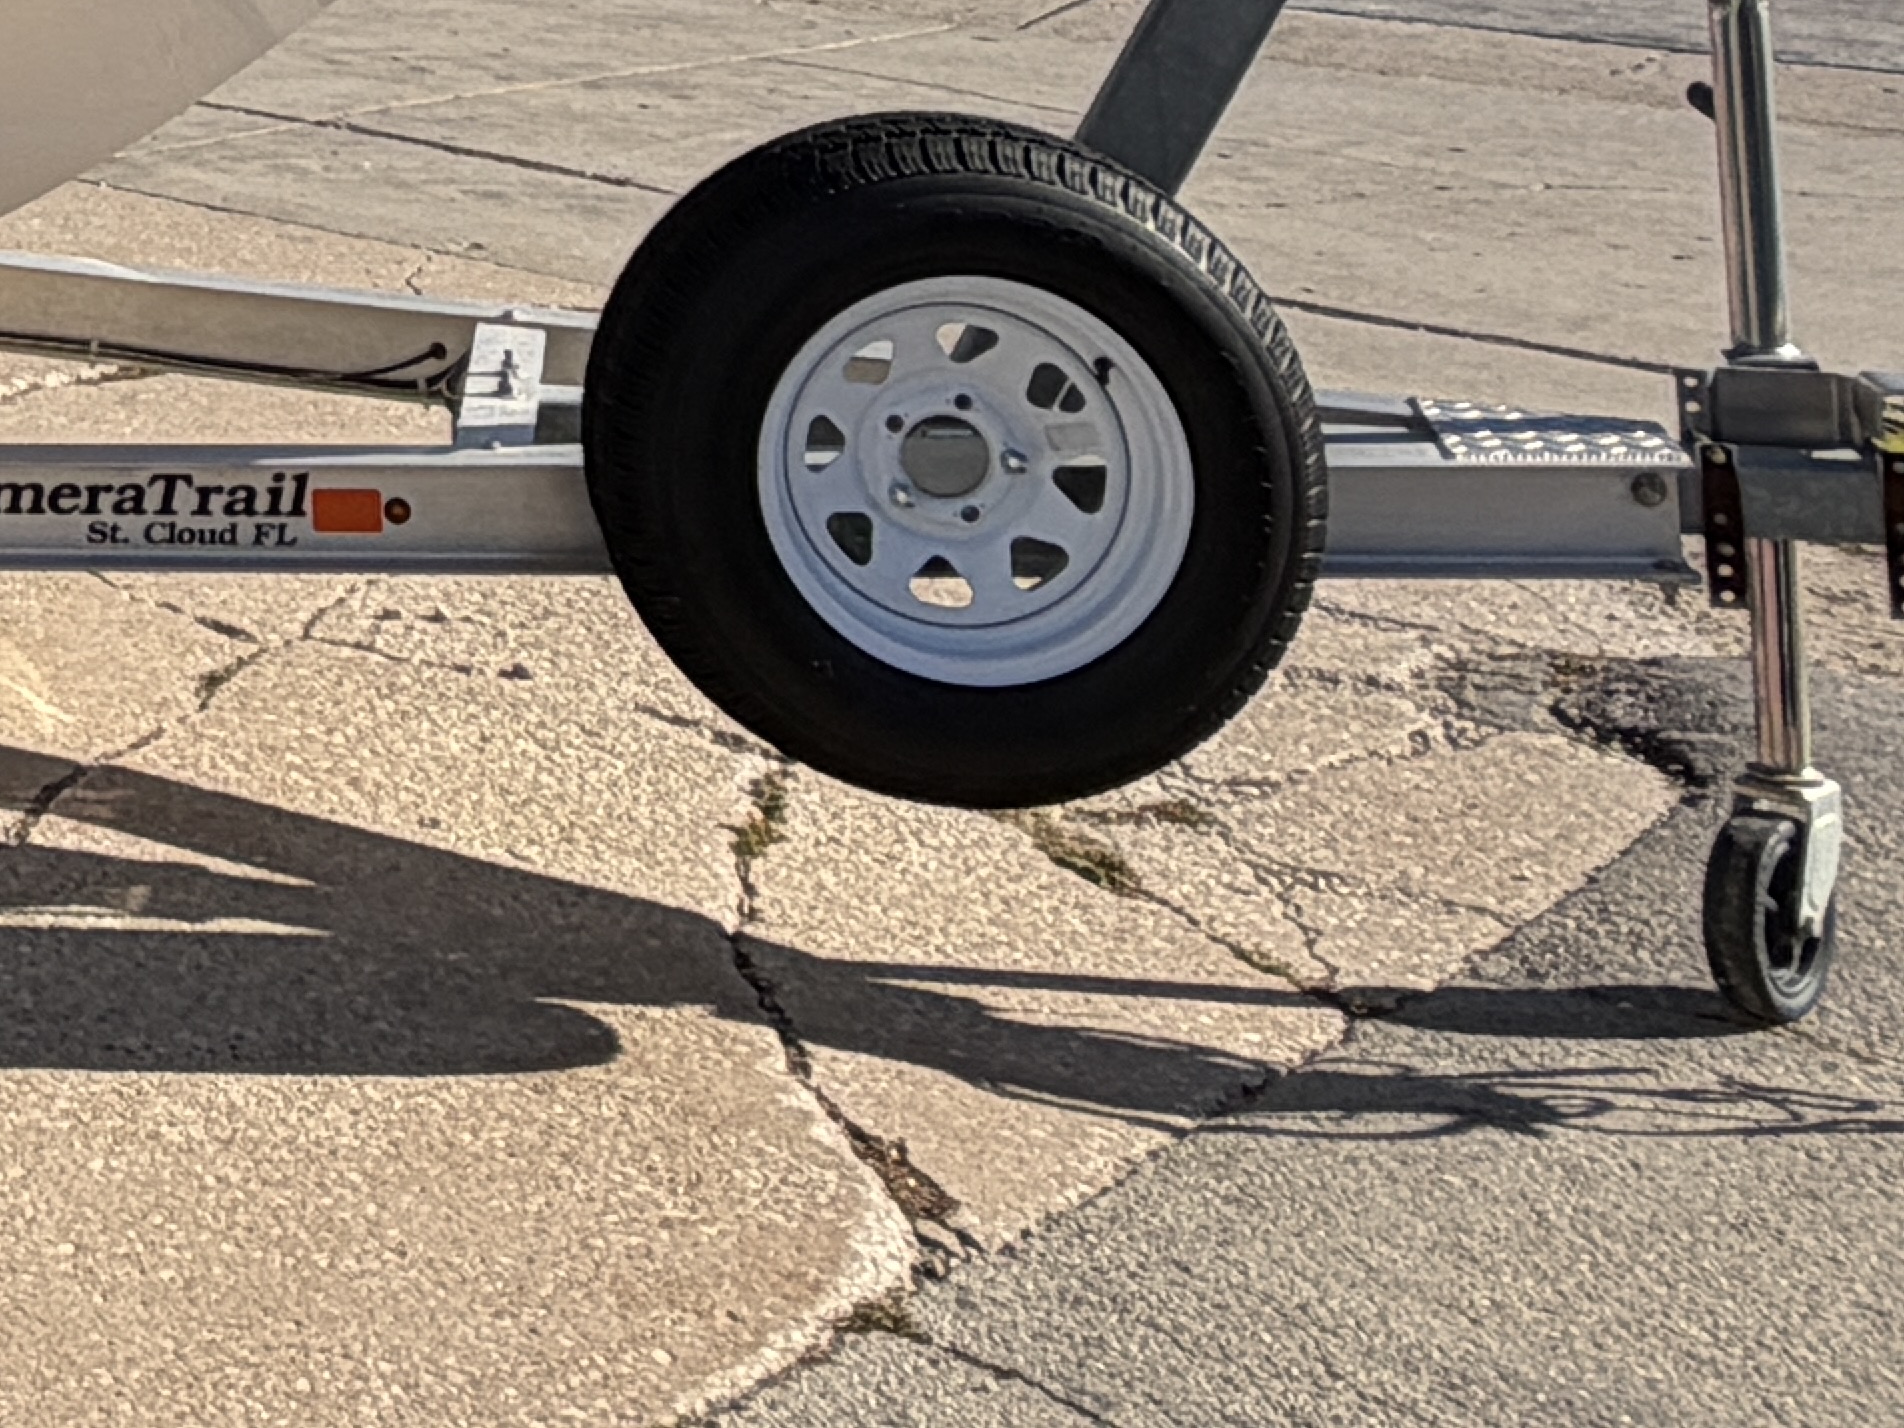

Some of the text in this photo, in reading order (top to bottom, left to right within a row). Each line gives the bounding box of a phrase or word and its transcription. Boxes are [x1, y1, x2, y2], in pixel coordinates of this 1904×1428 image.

[85, 520, 298, 547] St. Cloud FL
